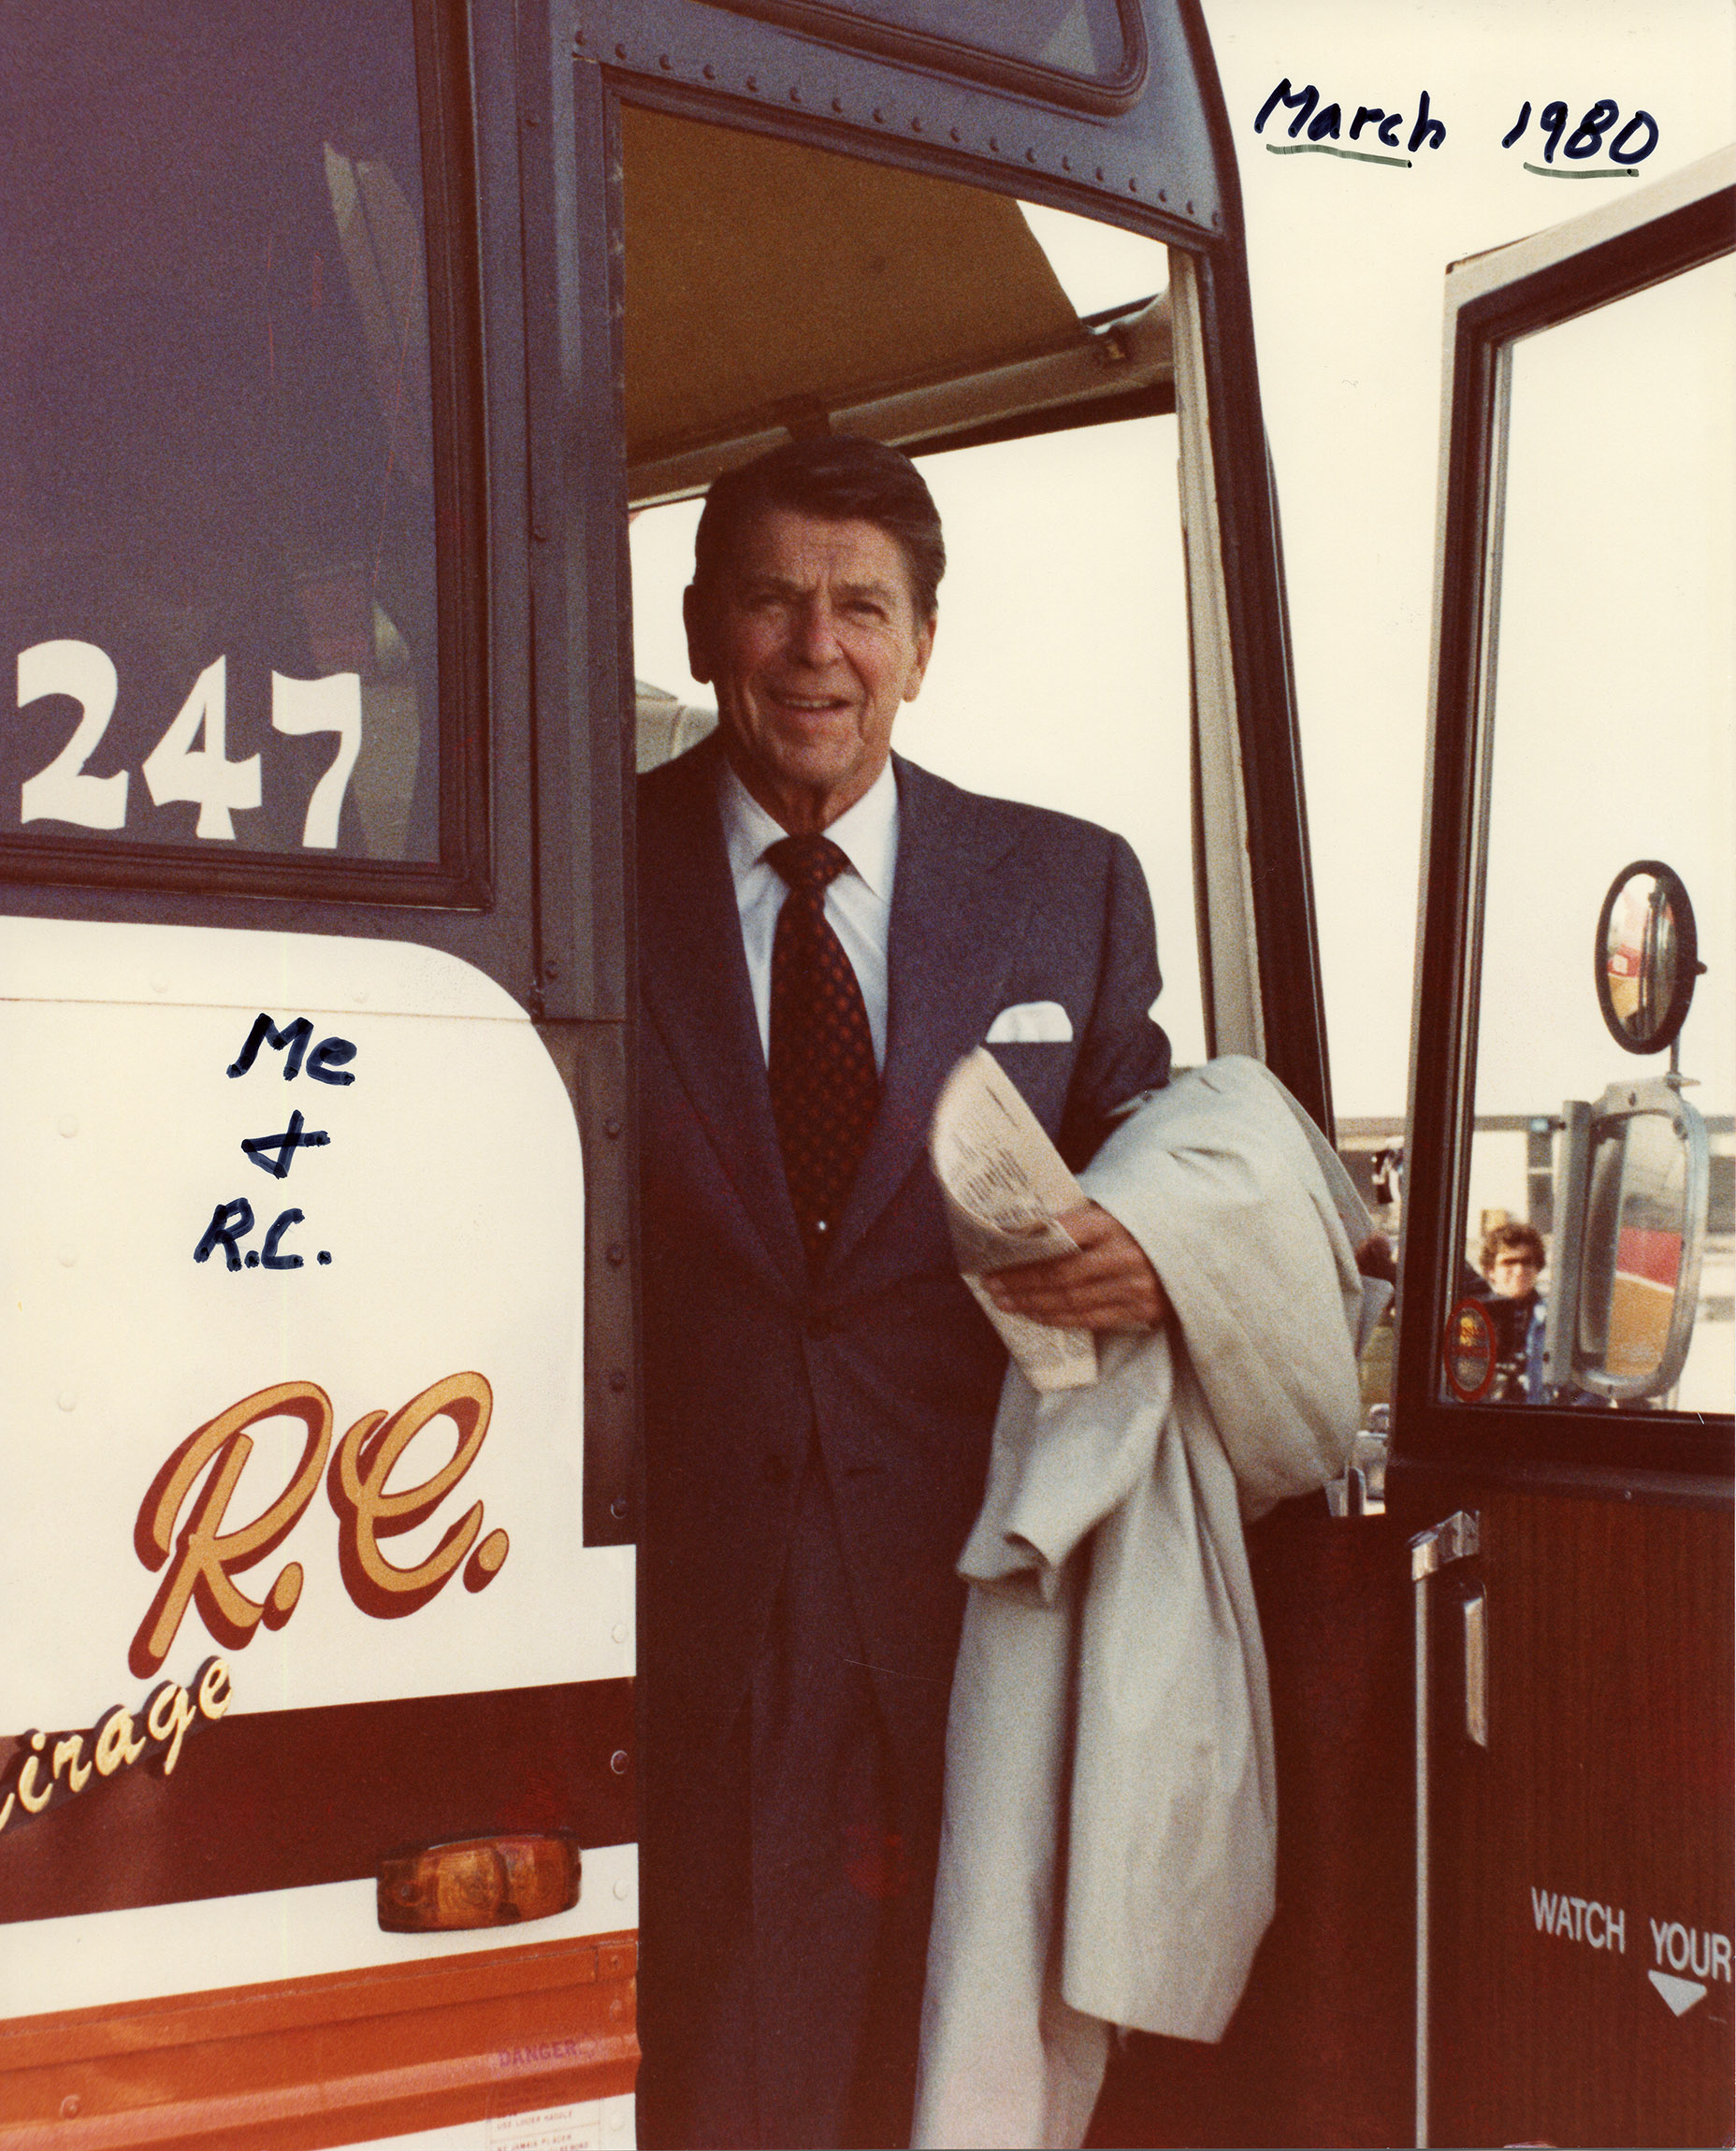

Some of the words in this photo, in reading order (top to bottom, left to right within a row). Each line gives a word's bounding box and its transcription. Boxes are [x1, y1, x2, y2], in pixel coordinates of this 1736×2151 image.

[1253, 78, 1447, 152] March
[1501, 99, 1659, 165] 1980
[17, 639, 363, 849] 247
[225, 1012, 357, 1087] Me
[193, 1197, 333, 1273] R.C.
[128, 1370, 510, 1680] R.C.
[0, 1655, 232, 1831] irage
[1530, 1885, 1626, 1955] WATCH
[1649, 1917, 1732, 1984] YOUR
